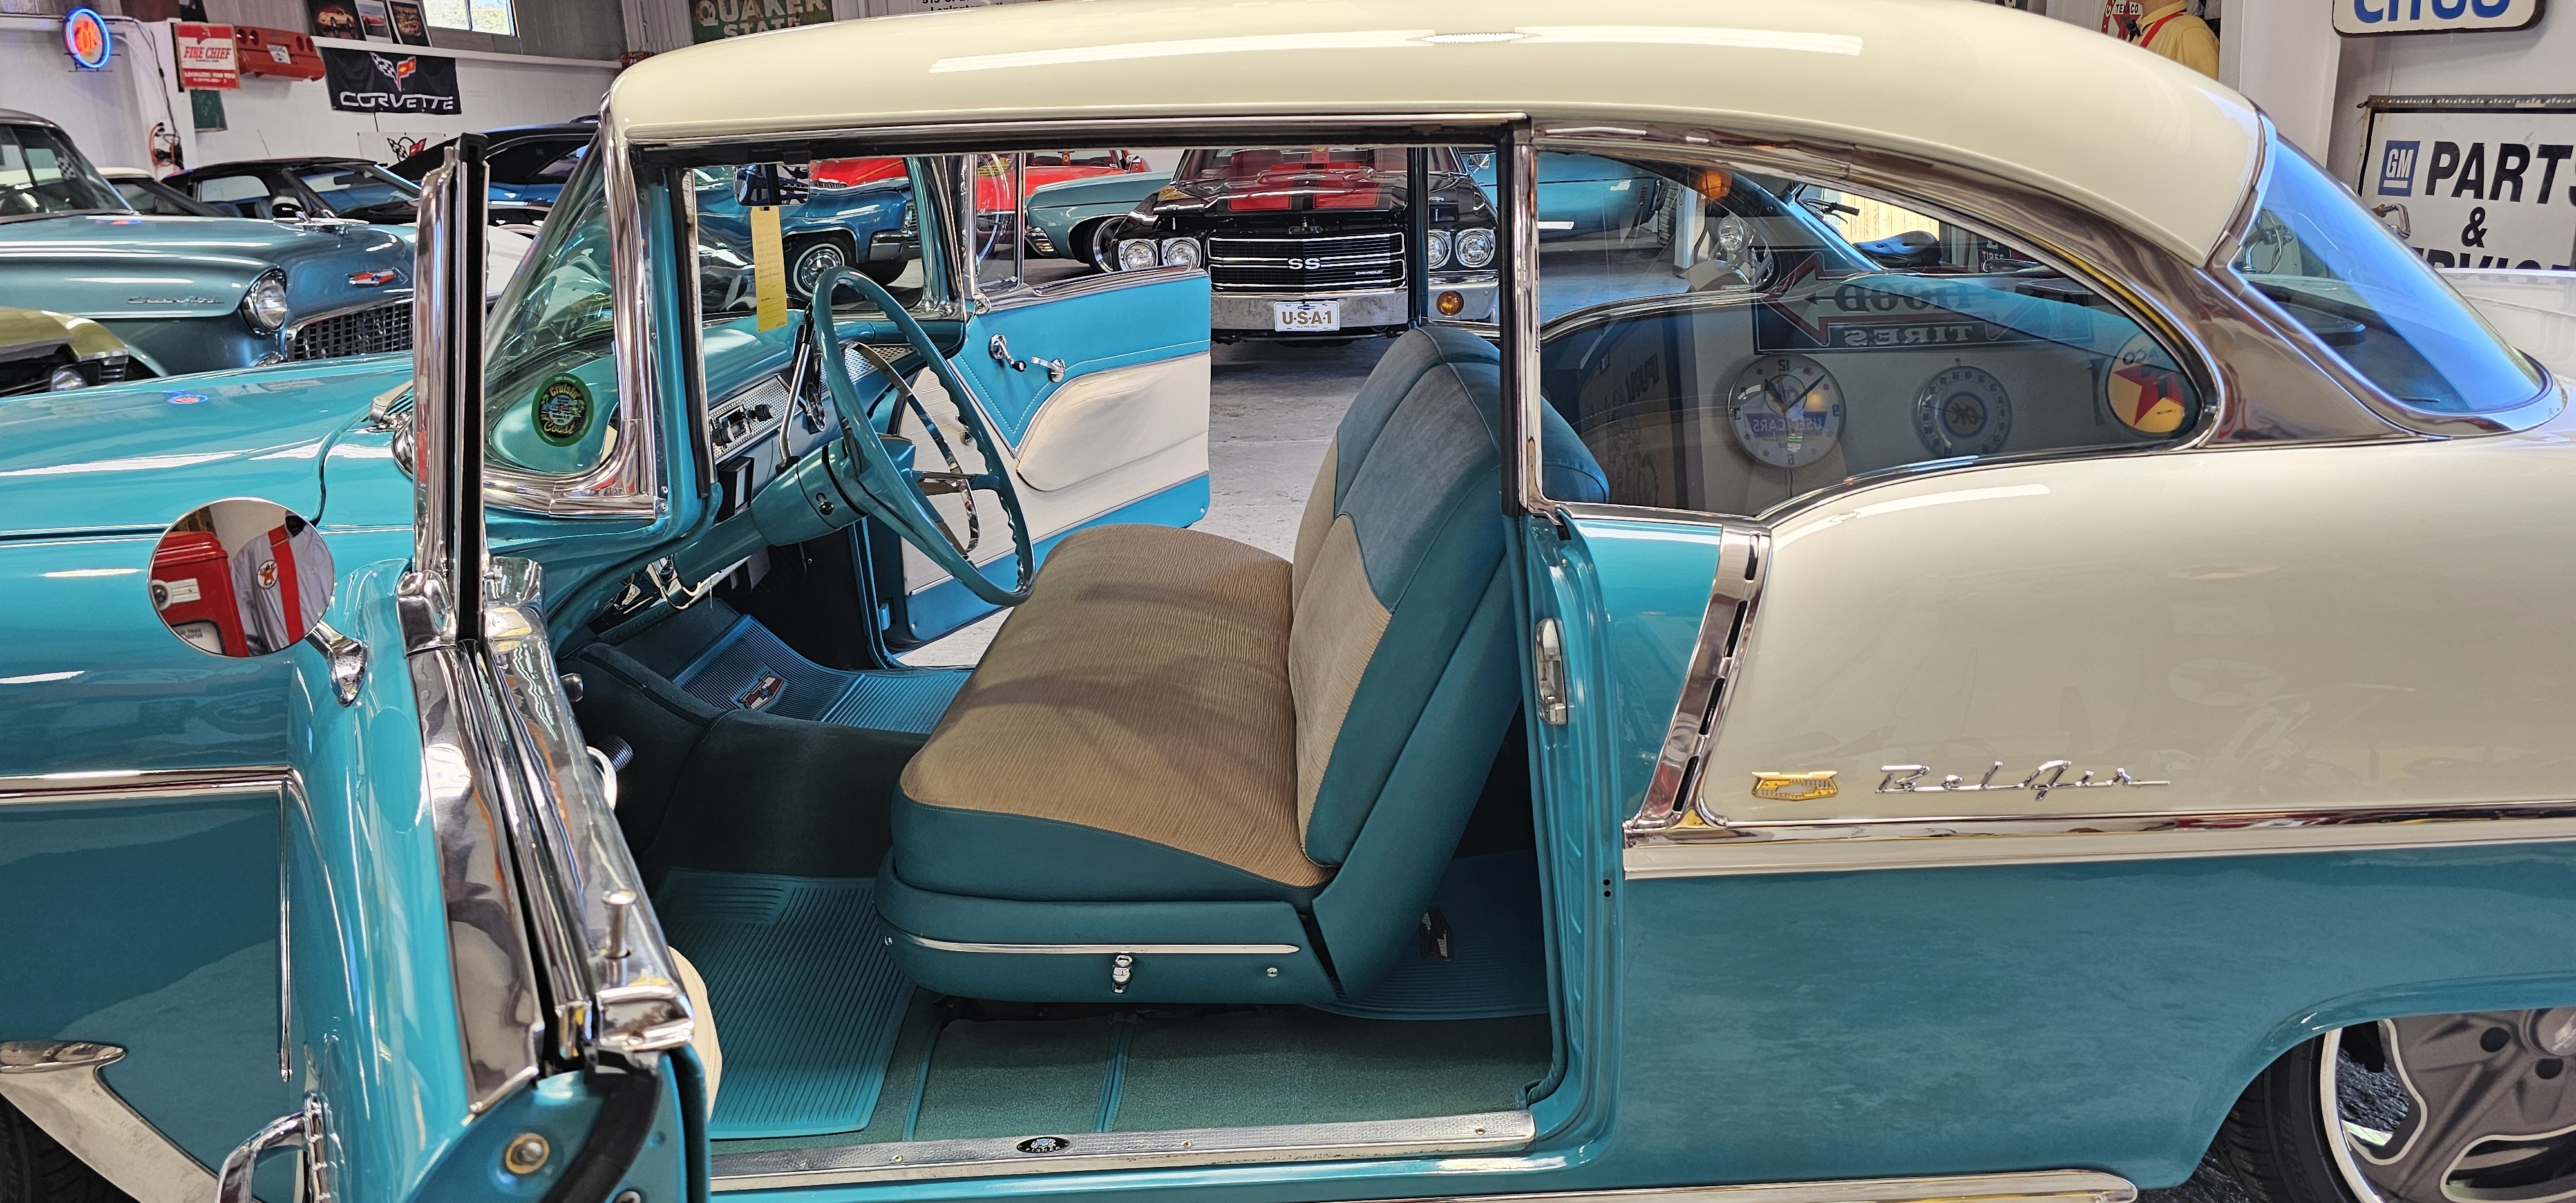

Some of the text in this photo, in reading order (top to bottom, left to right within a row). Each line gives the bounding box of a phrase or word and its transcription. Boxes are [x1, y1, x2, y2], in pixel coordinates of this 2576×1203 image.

[2116, 3, 2139, 14] TECO
[723, 17, 800, 38] STATE
[184, 46, 231, 59] FIRE CHIEF
[340, 91, 453, 109] CORVETTE
[2385, 140, 2576, 207] GM PART
[2461, 206, 2488, 249] &
[1288, 258, 1321, 270] SS
